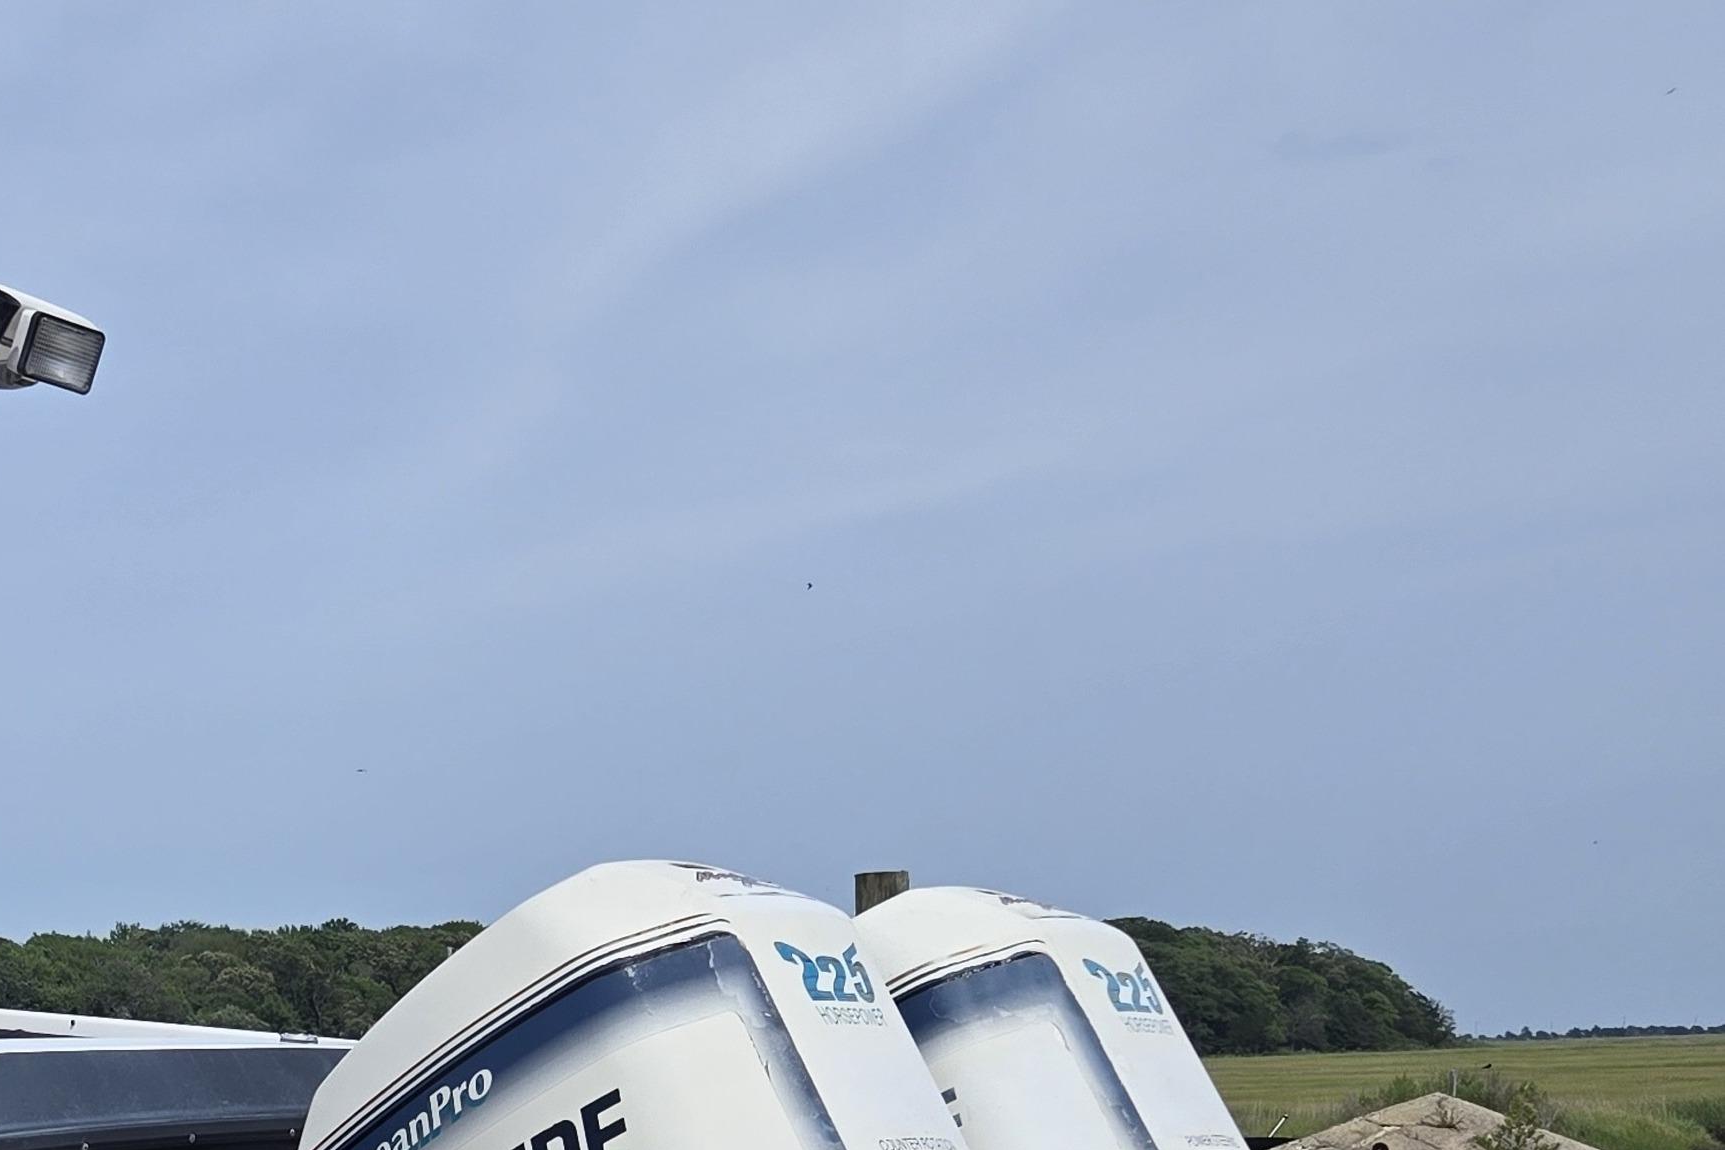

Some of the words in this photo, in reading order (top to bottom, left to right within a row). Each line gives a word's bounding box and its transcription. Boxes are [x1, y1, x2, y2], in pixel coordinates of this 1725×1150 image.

[774, 941, 875, 1003] 225
[1082, 959, 1163, 1015] 225
[815, 1005, 888, 1027] HORSEPOWER
